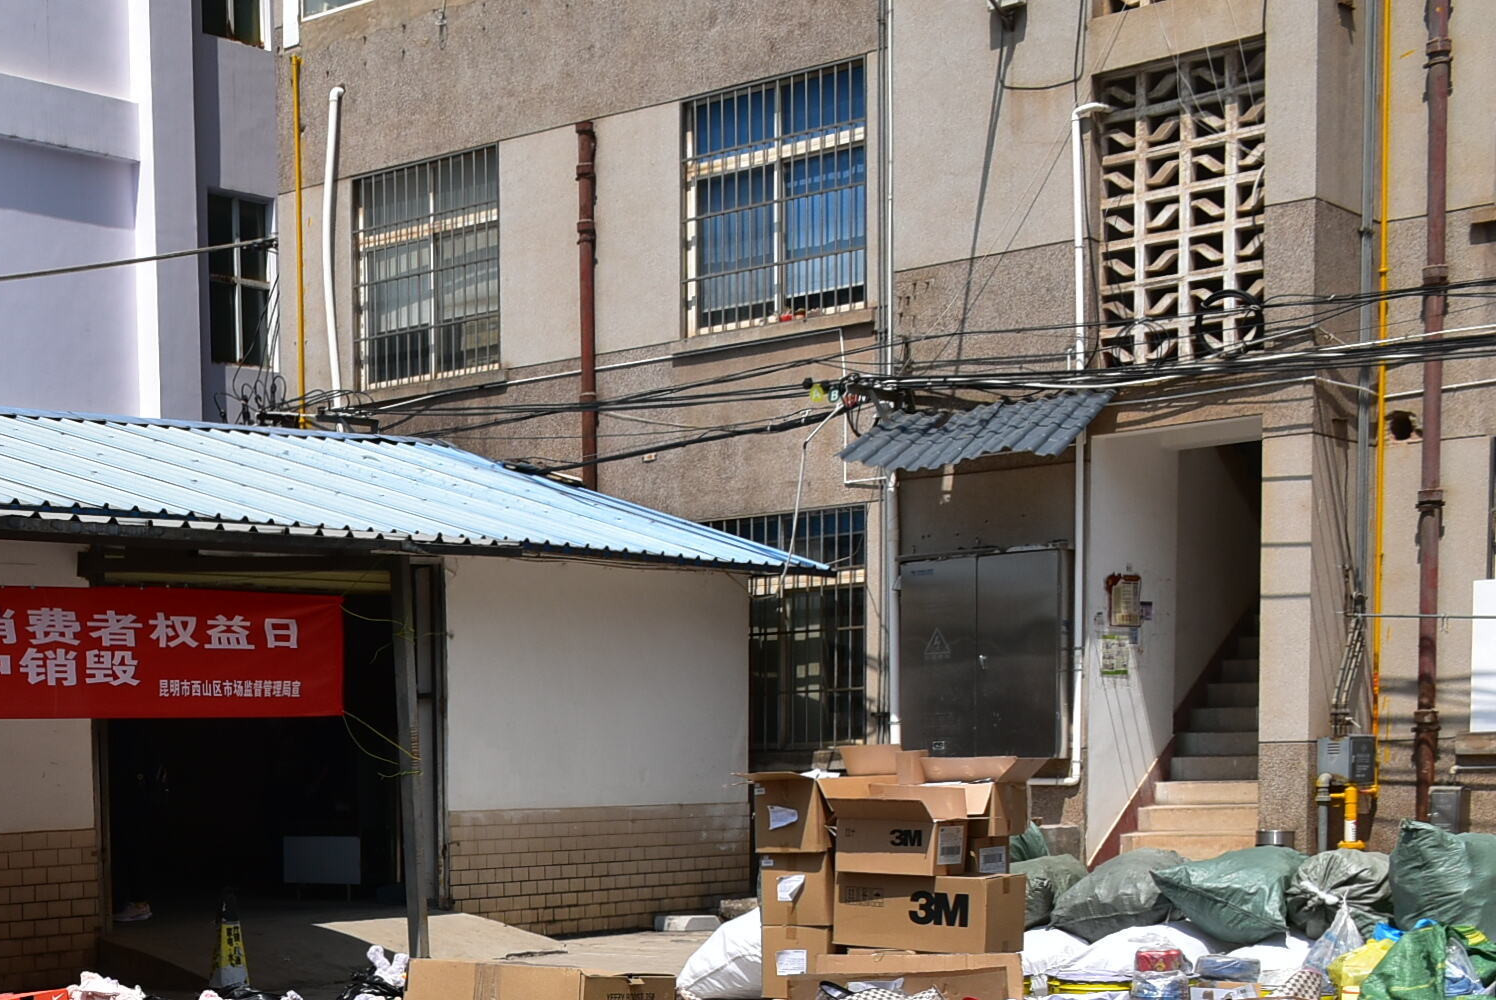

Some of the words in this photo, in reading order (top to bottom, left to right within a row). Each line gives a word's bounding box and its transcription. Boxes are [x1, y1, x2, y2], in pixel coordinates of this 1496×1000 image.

[830, 390, 839, 401] B
[159, 679, 302, 698] 昆明市西山区市场监督管理局宣
[890, 829, 923, 847] 3M
[908, 890, 970, 928] 3M
